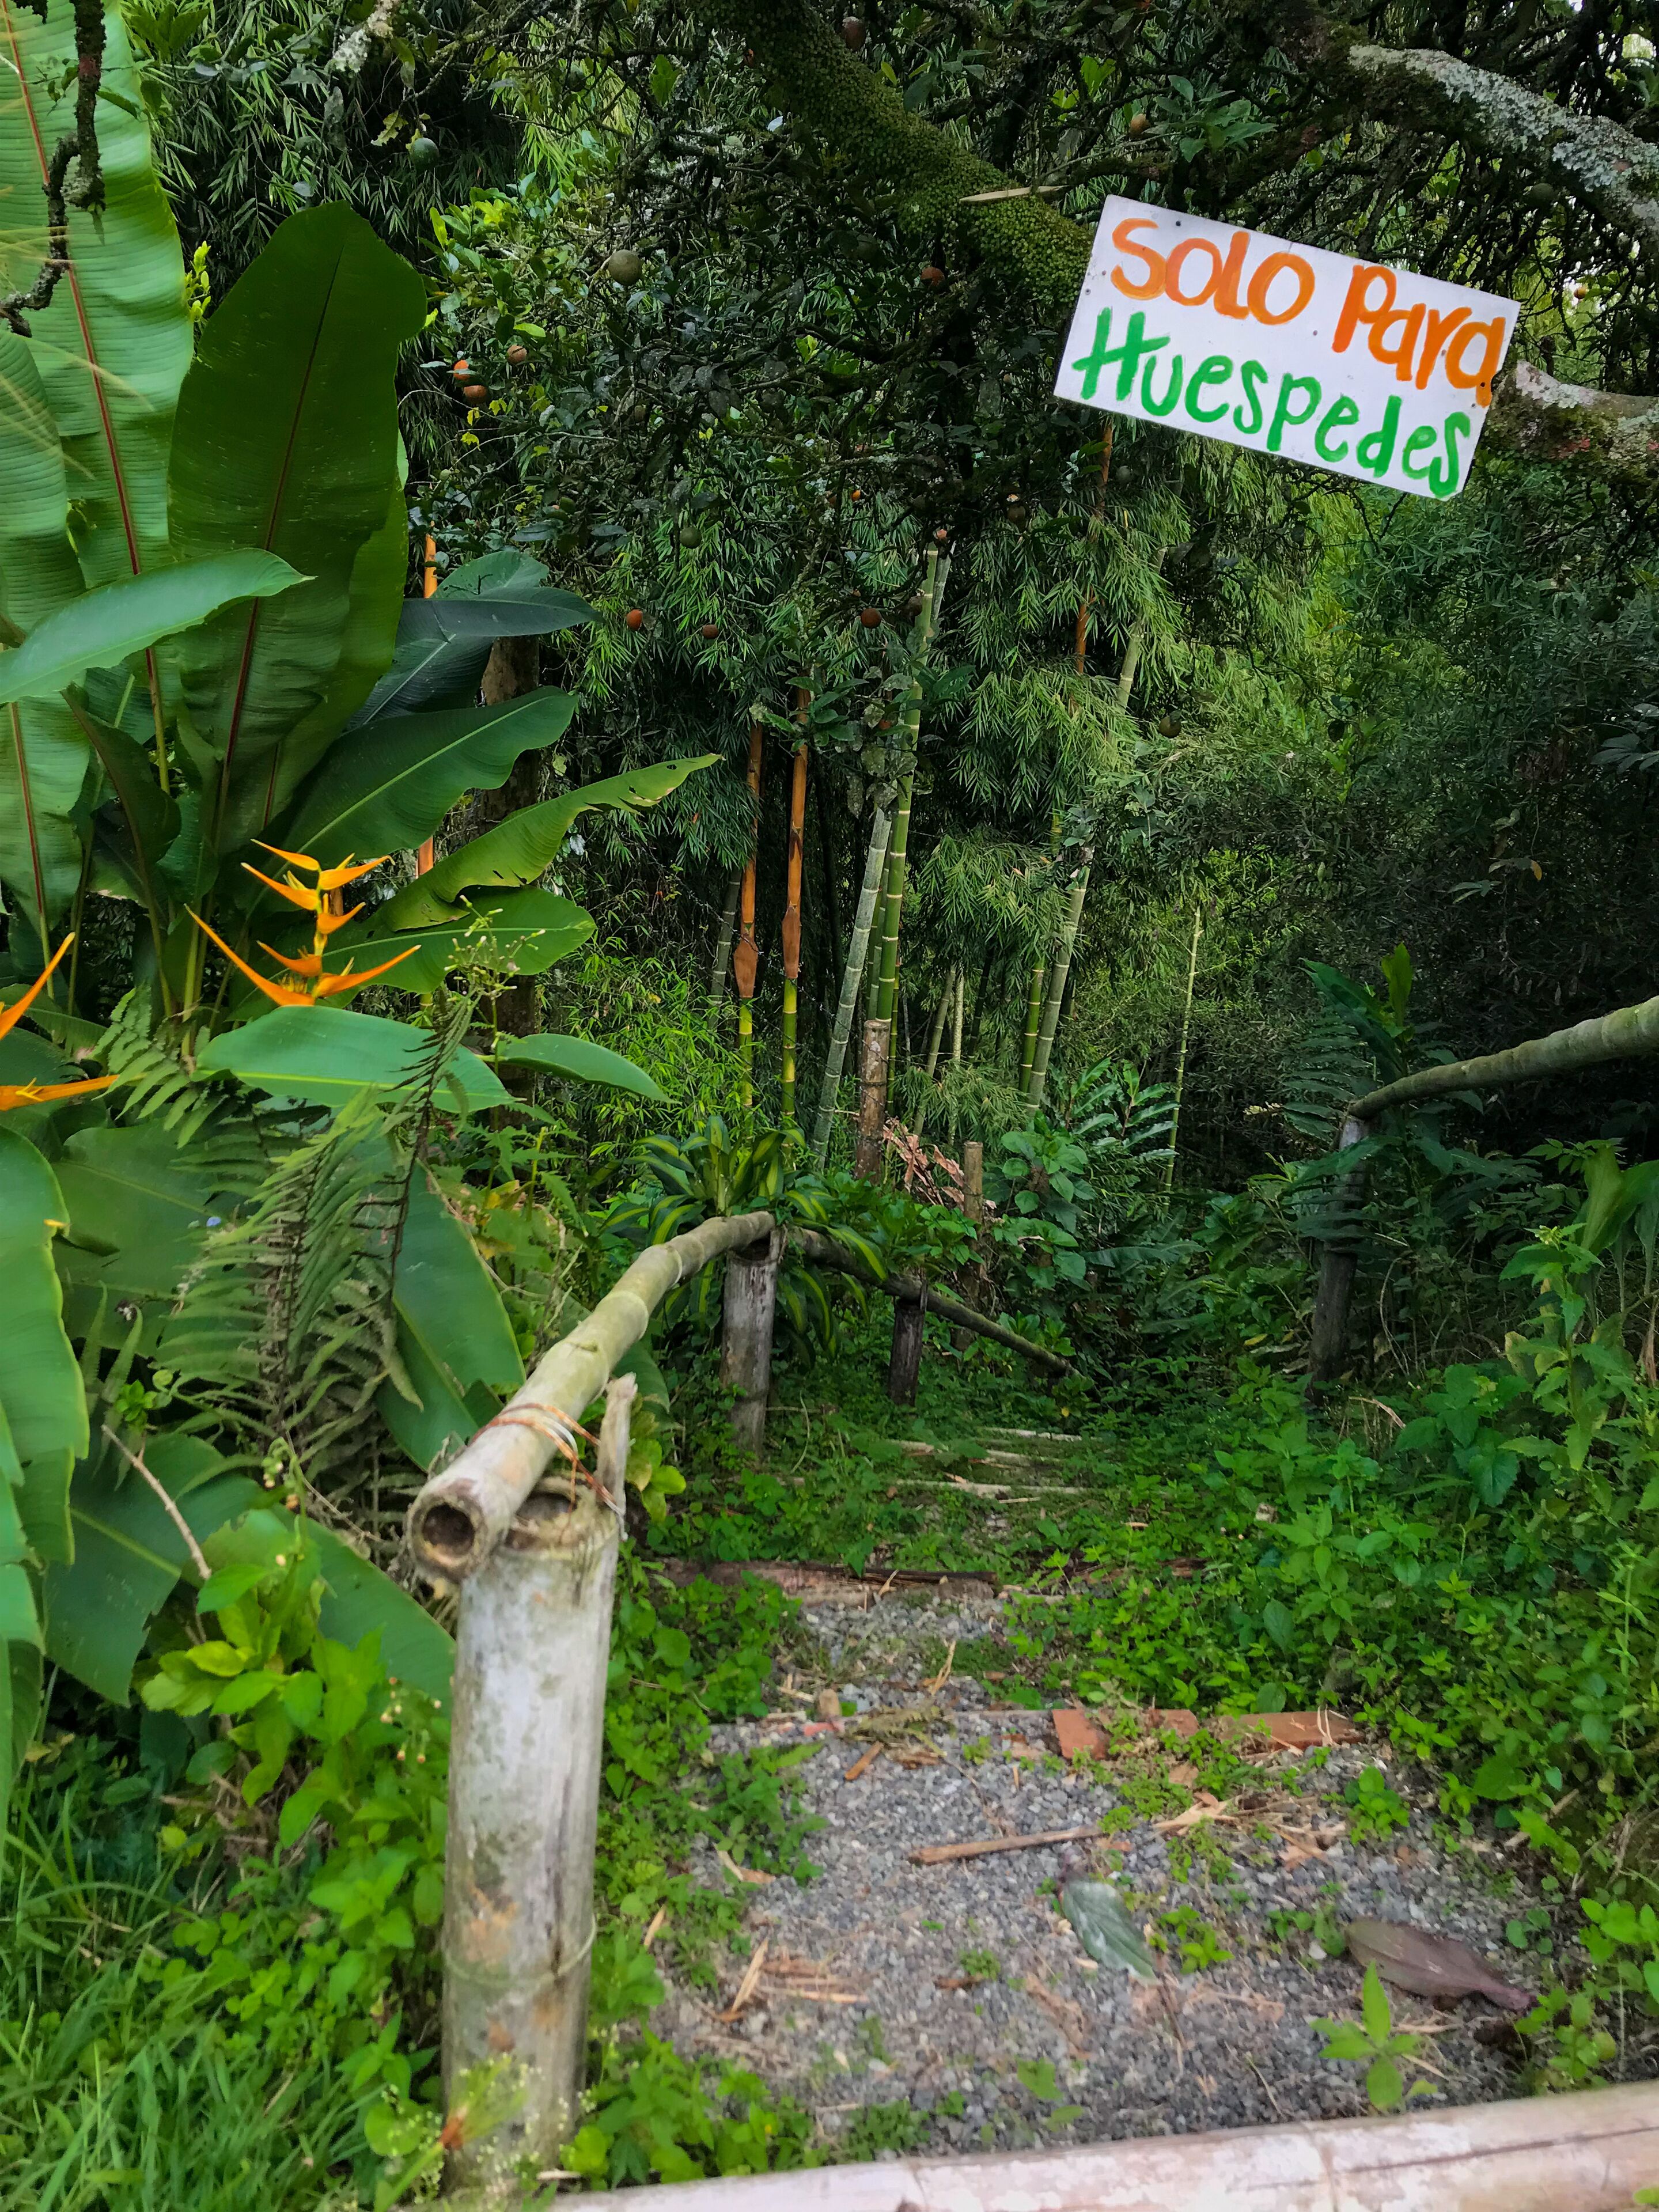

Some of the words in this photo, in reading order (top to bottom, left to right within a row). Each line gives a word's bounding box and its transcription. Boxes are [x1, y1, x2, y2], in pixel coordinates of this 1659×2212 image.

[1072, 307, 1471, 498] Huespedes
[1111, 218, 1315, 325] SOLO
[1332, 265, 1506, 408] Para
